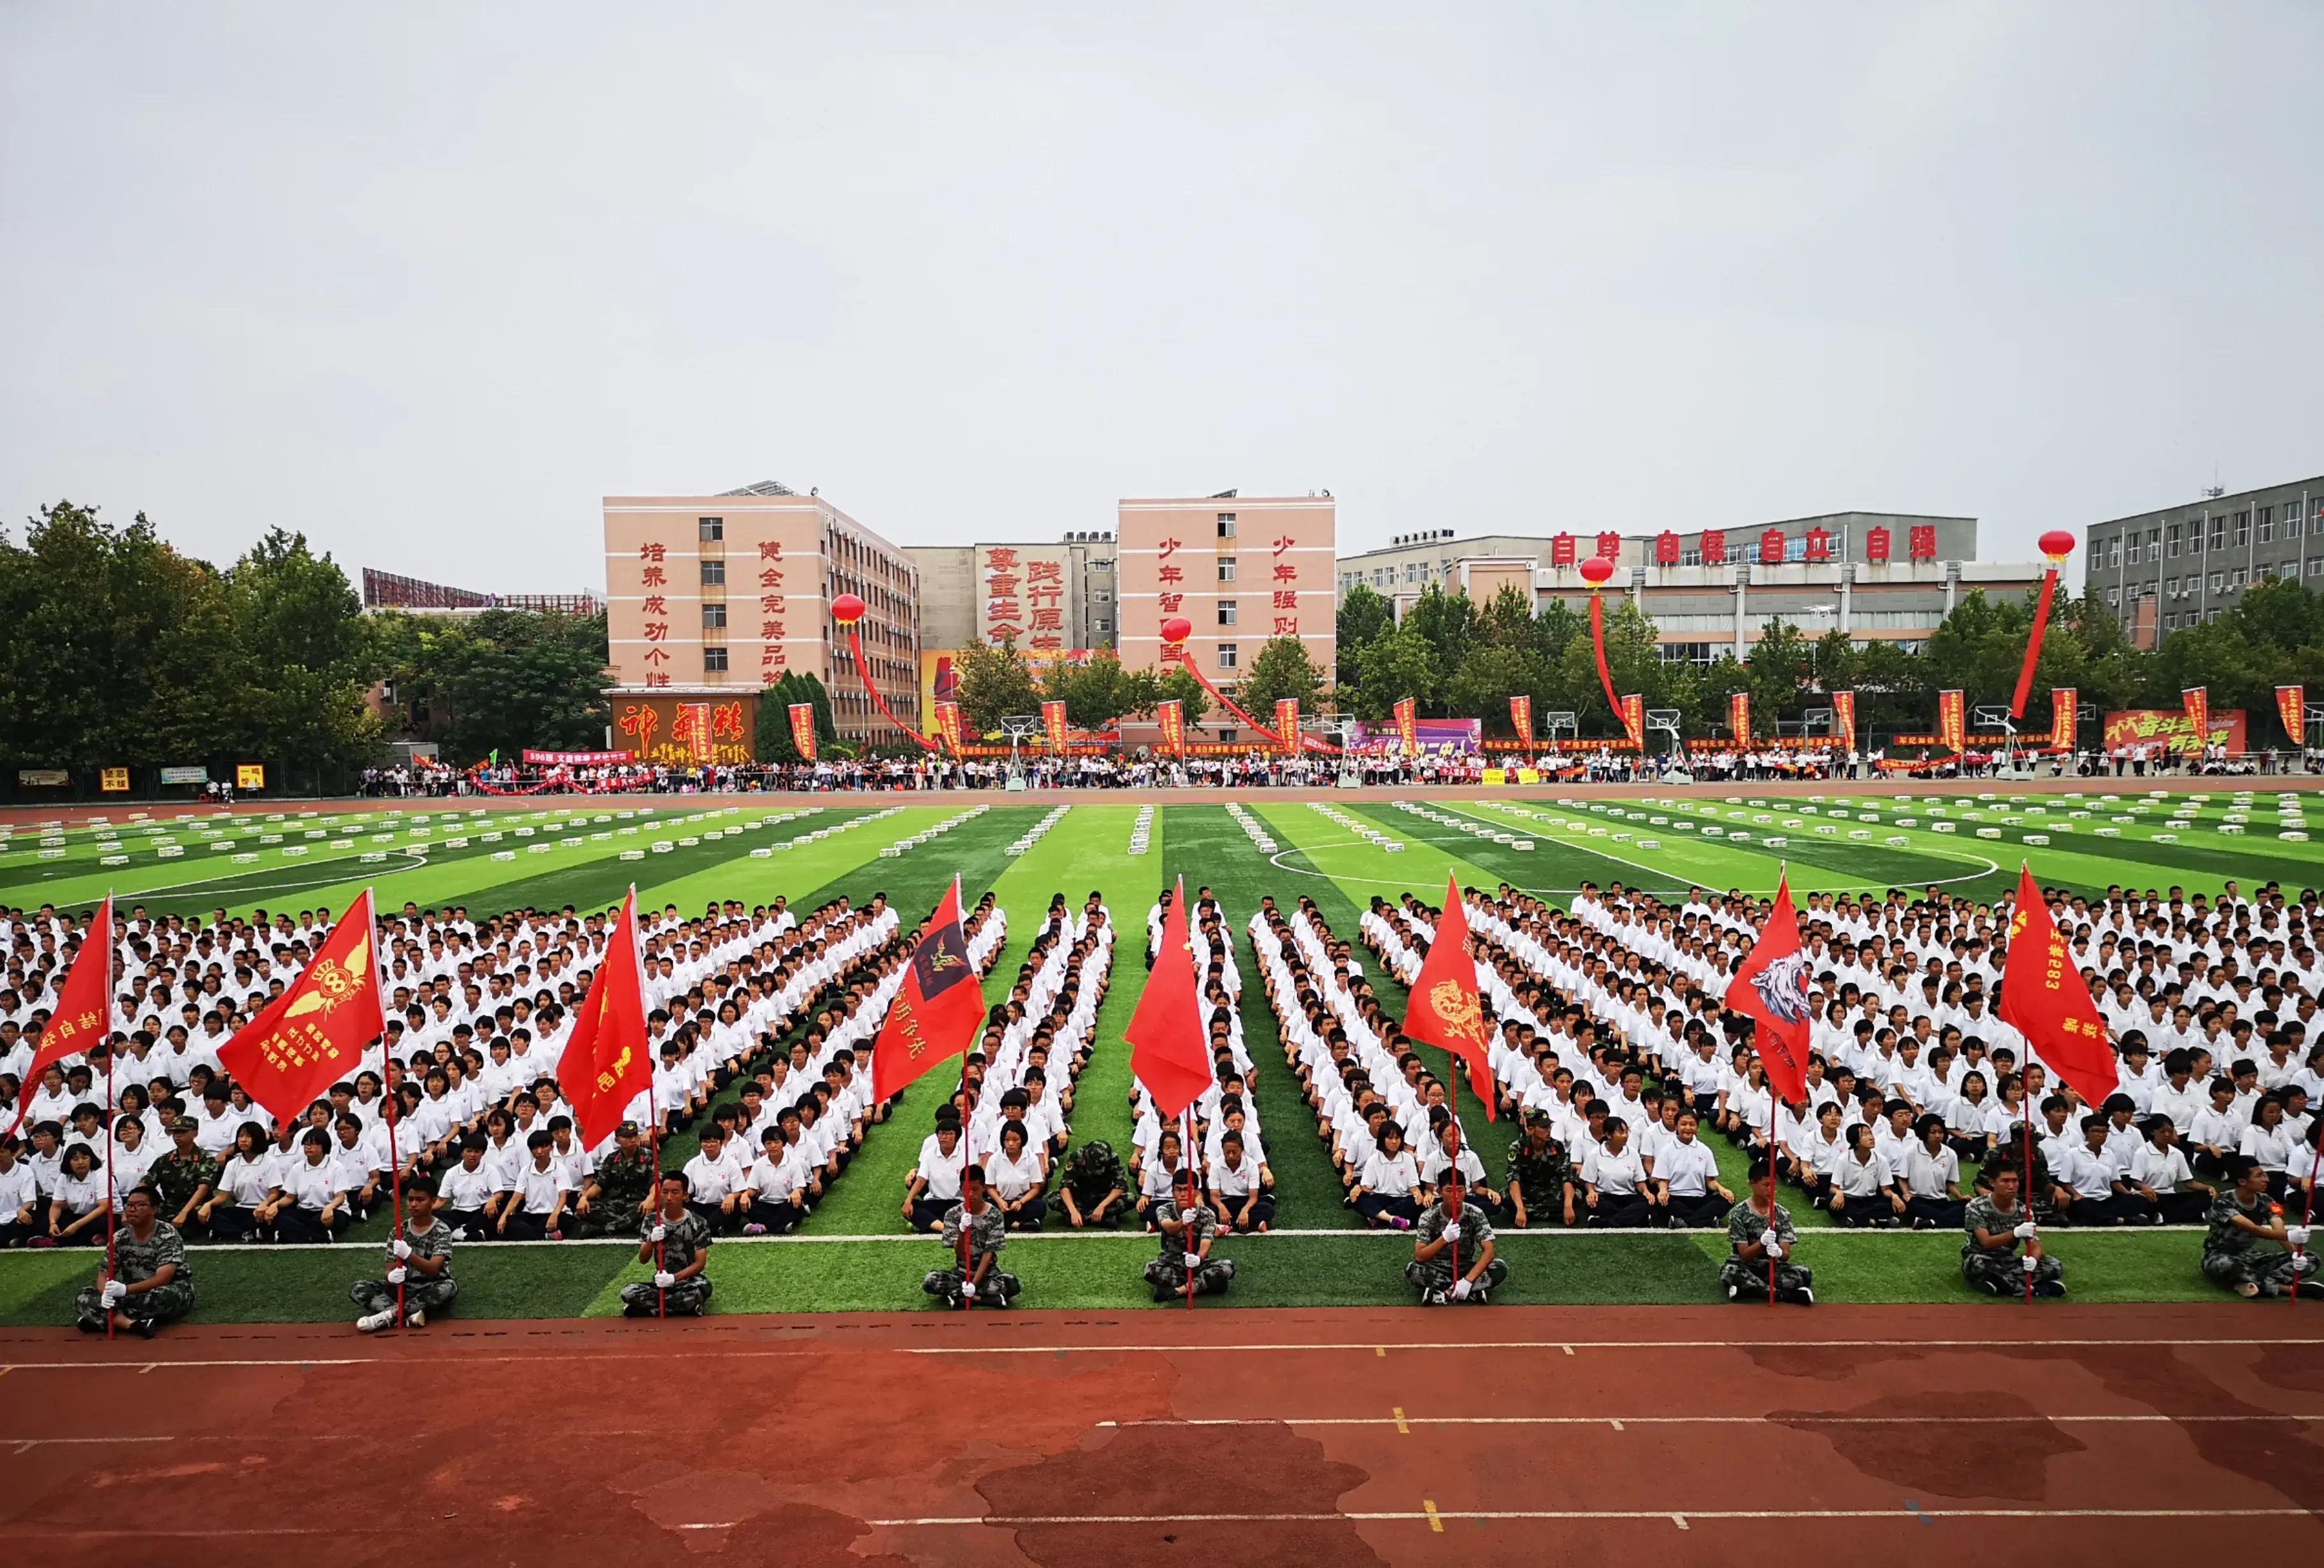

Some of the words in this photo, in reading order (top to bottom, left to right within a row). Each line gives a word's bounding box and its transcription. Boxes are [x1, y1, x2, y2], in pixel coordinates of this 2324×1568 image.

[1761, 528, 1830, 562] 自立
[1867, 525, 1935, 558] 自强
[105, 780, 126, 788] 不拔
